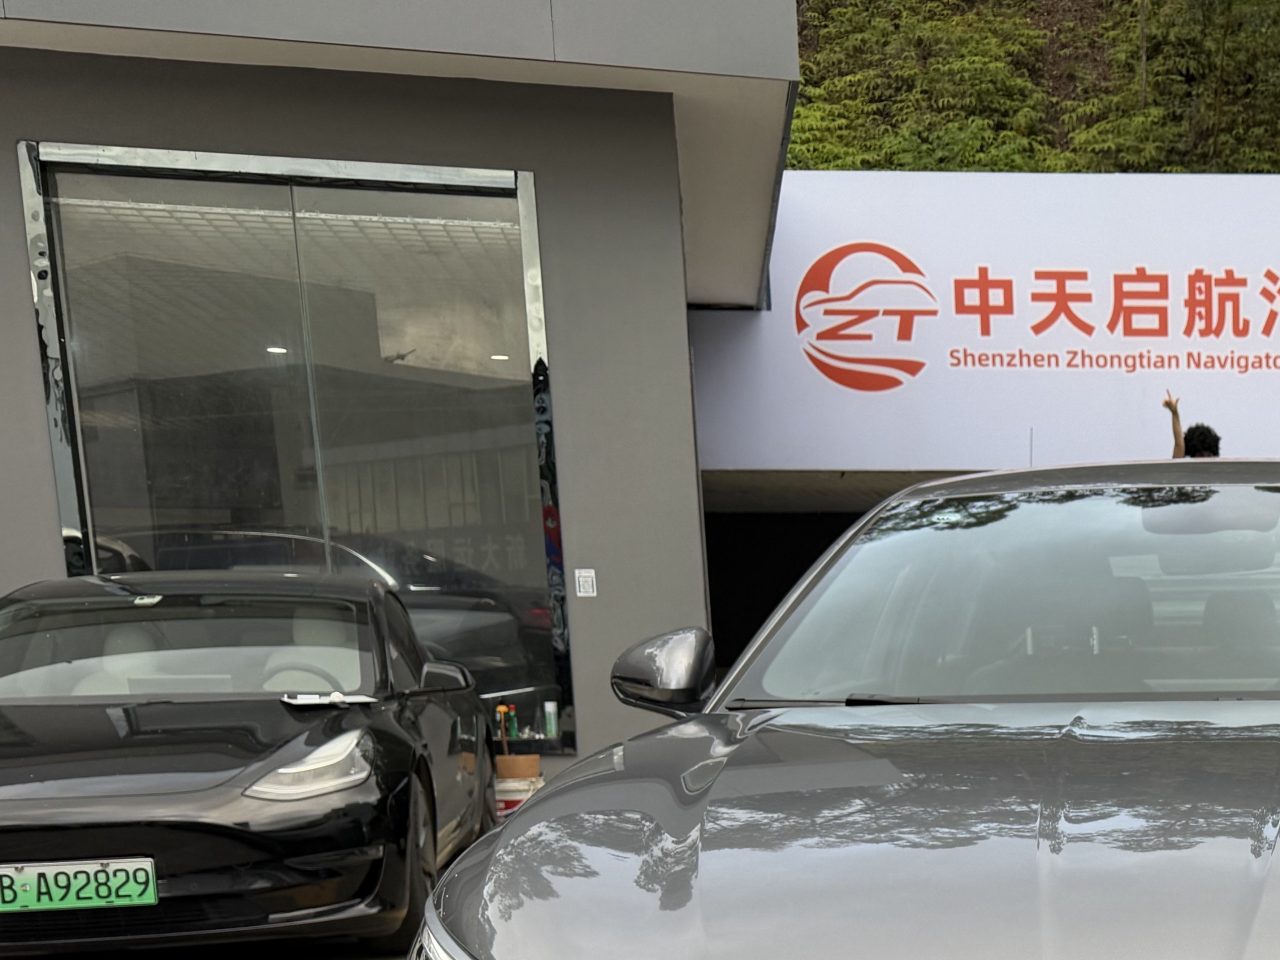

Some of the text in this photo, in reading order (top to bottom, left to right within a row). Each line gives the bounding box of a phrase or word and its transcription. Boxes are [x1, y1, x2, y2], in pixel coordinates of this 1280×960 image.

[816, 309, 939, 341] ZT
[949, 348, 1060, 368] Shenzhen
[1066, 350, 1180, 374] Zhongtian
